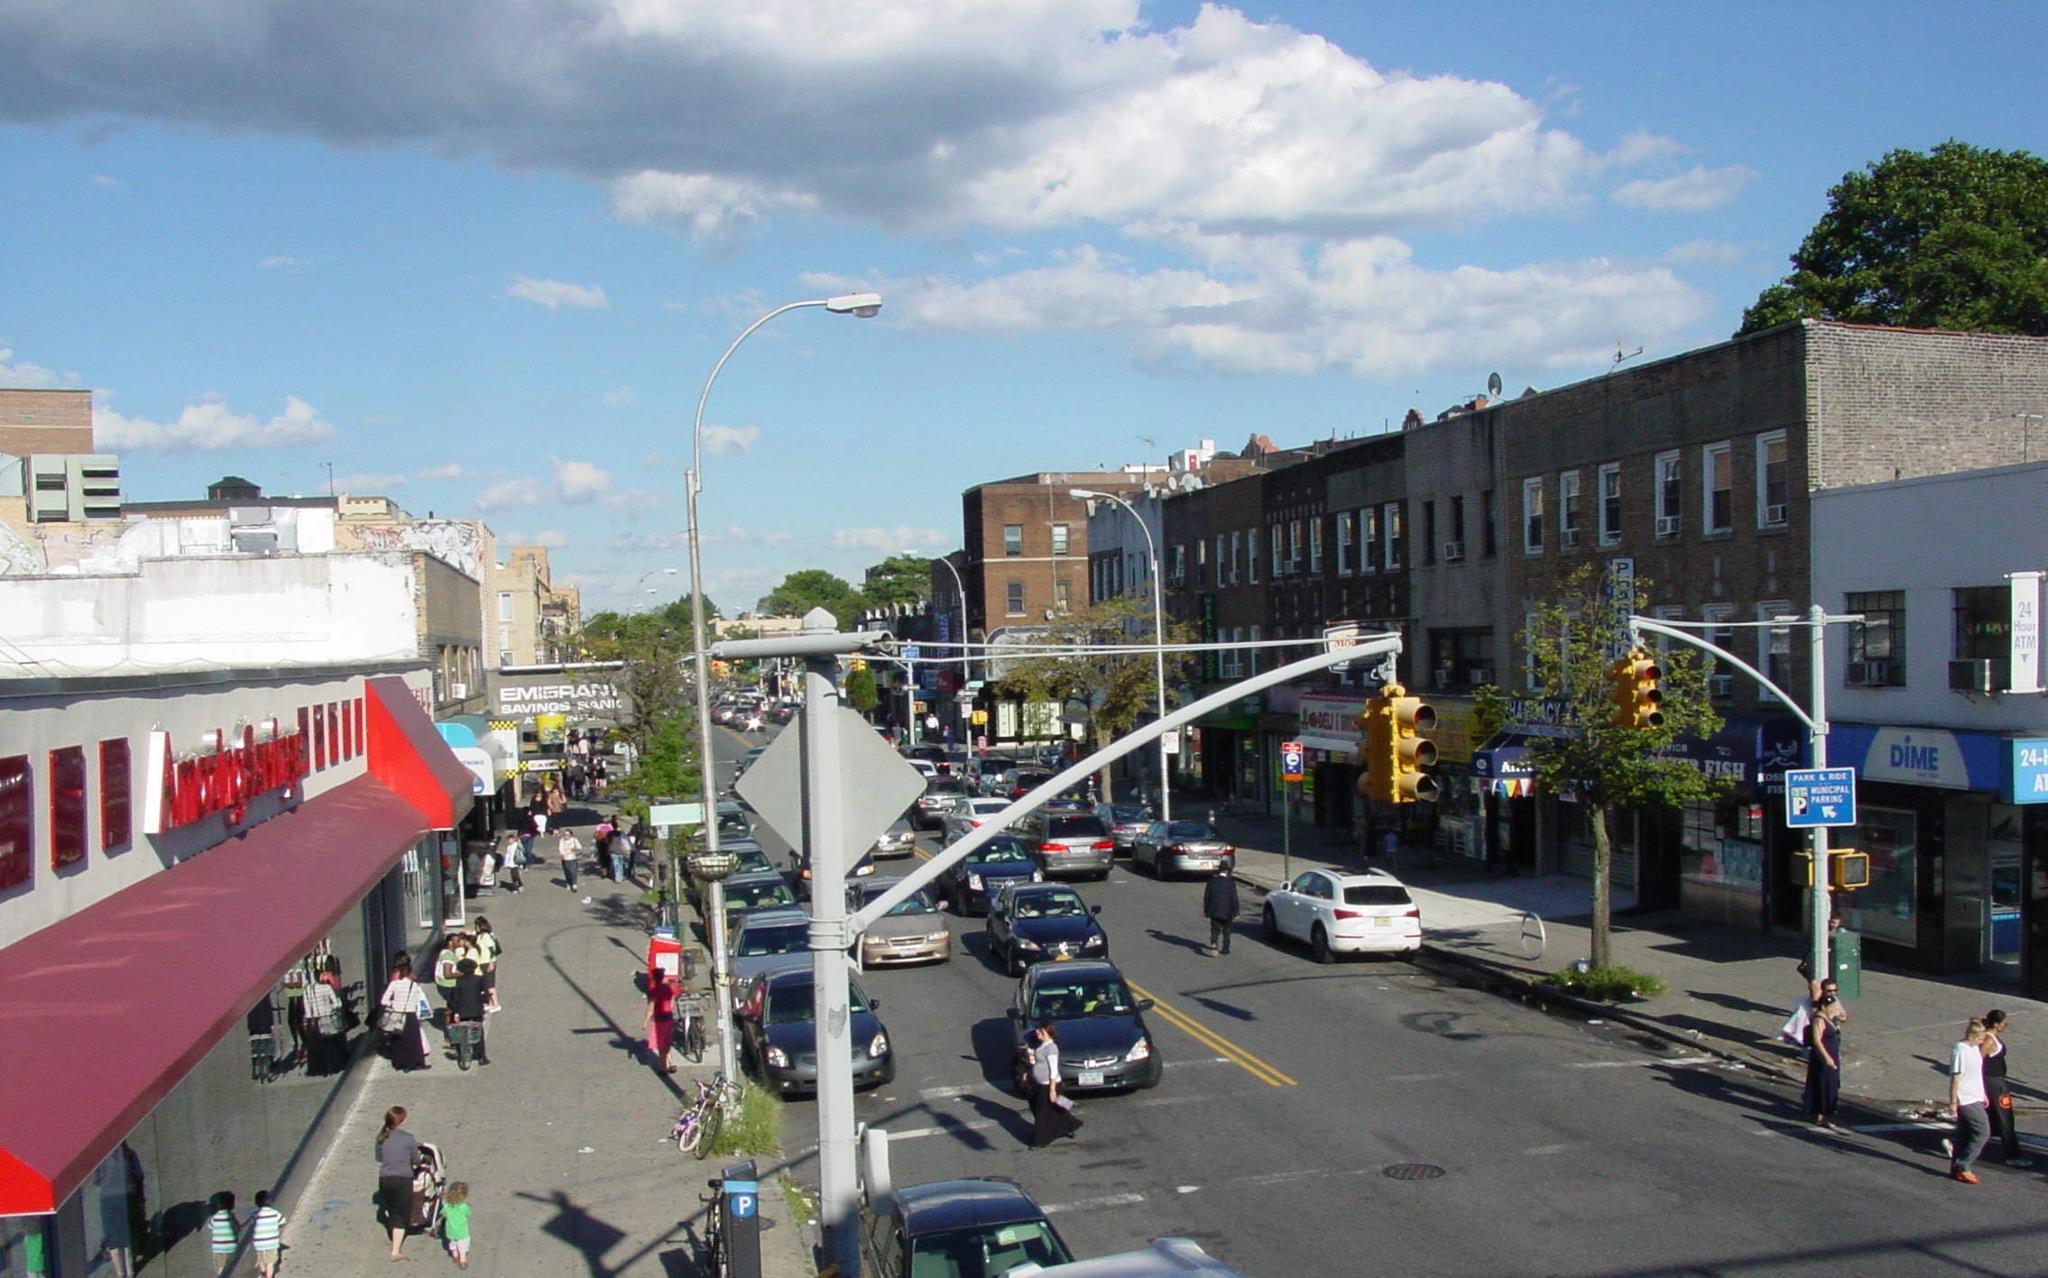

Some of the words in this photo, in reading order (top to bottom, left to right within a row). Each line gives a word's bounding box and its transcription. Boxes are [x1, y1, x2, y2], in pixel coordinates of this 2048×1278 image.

[2018, 602, 2032, 618] 24
[2014, 621, 2036, 632] Hour
[2014, 636, 2036, 649] ATM
[501, 702, 571, 714] SAVINGS
[1704, 759, 1746, 781] FISH
[1792, 774, 1815, 782] PARK
[1828, 773, 1848, 781] RIDE
[1811, 785, 1851, 794] MUNICIPAL
[1811, 795, 1844, 804] PARKING
[1793, 797, 1807, 816] P
[738, 1196, 752, 1215] P
